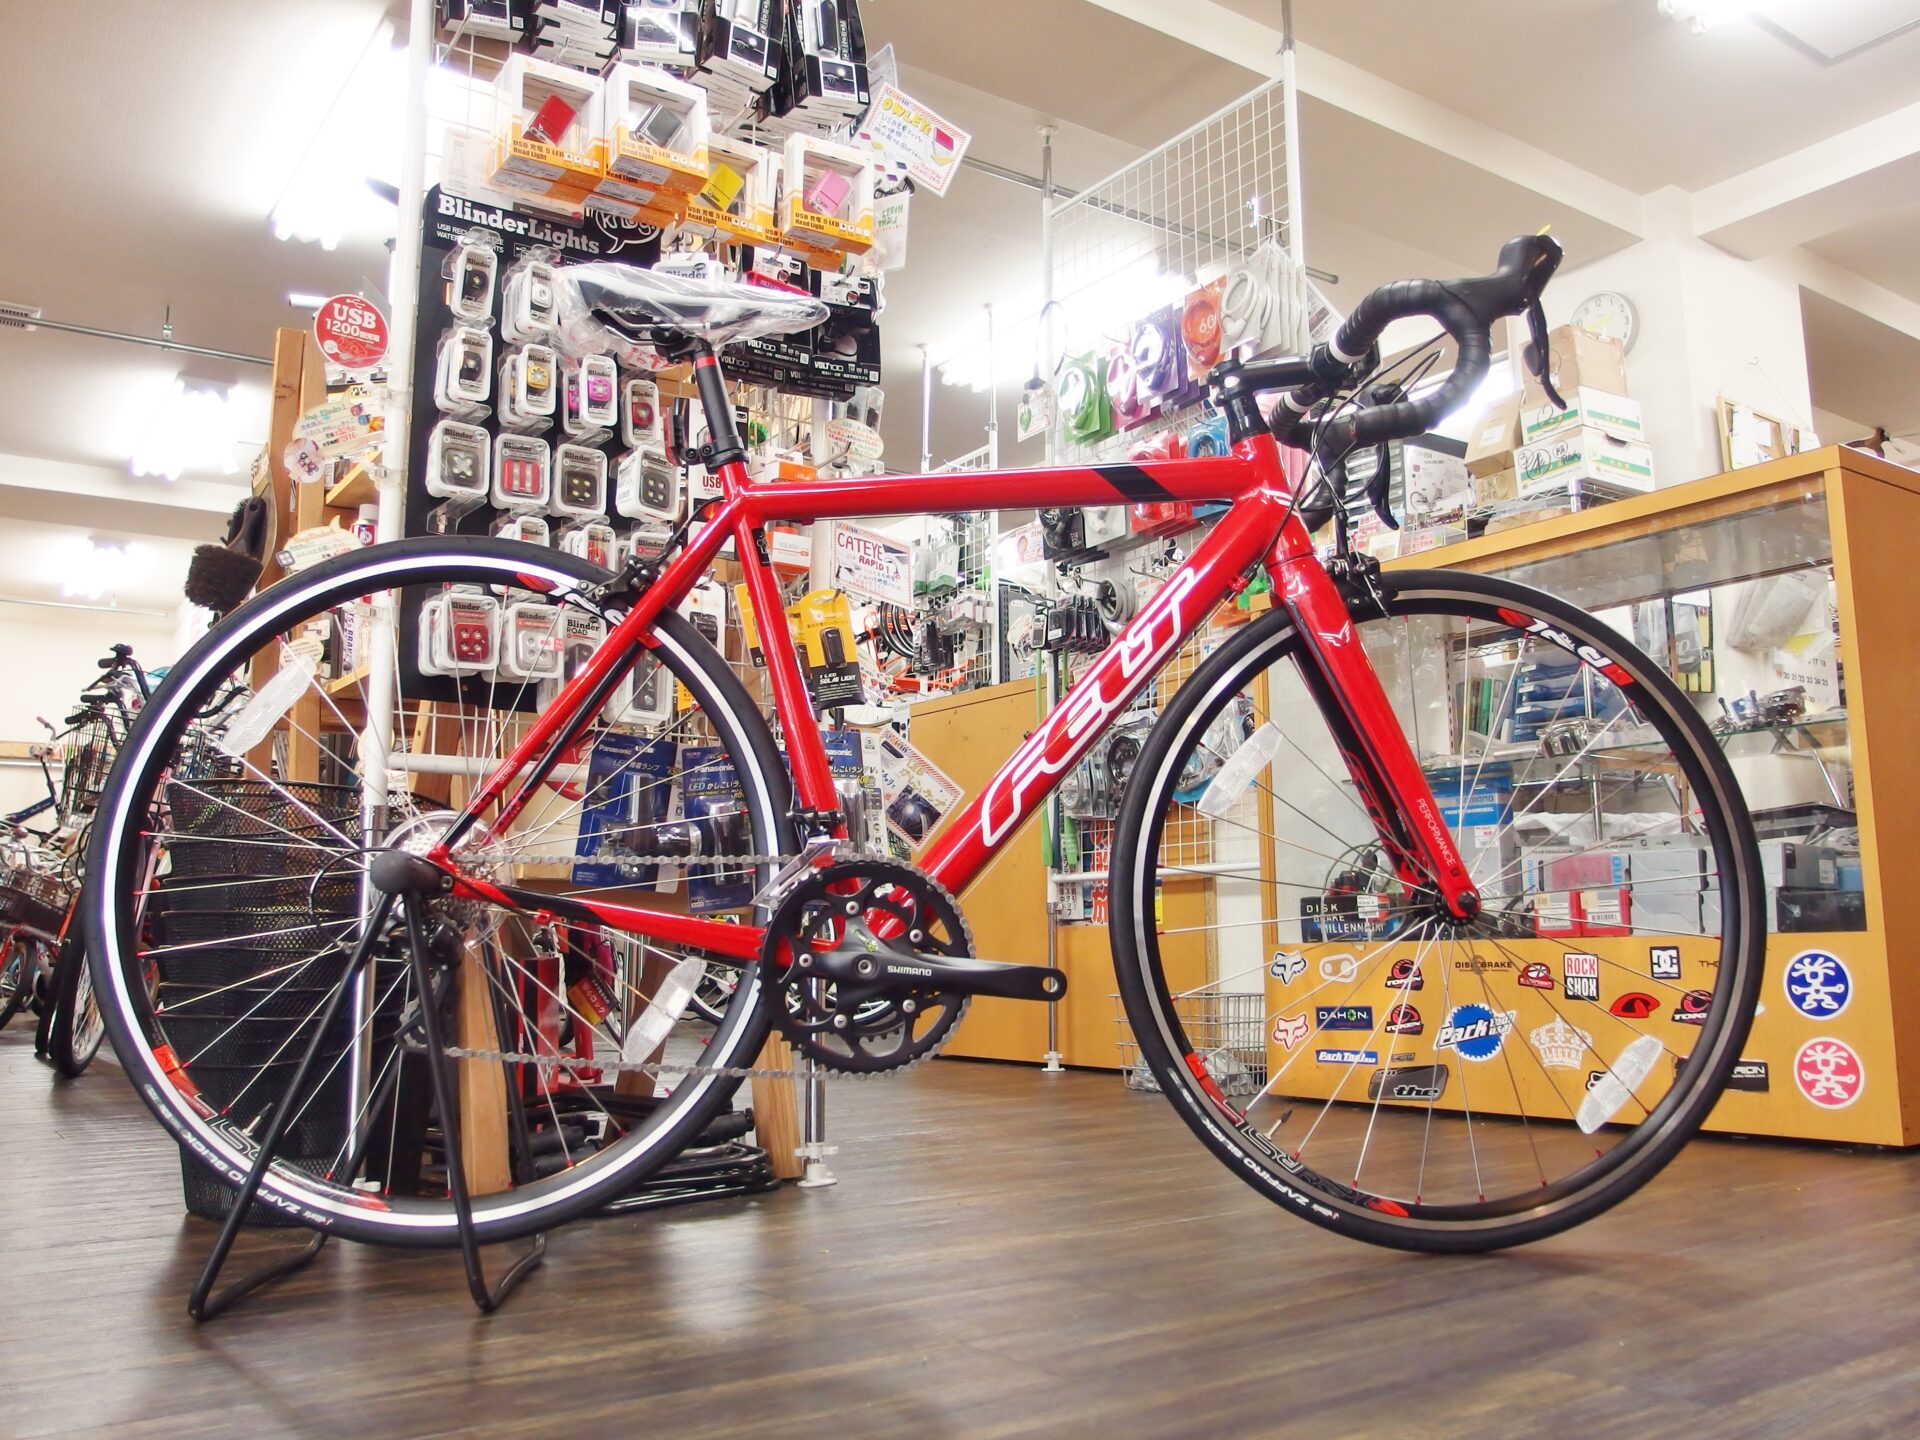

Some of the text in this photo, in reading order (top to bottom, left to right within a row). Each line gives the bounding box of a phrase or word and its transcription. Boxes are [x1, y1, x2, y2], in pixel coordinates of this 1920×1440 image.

[436, 222, 451, 232] USB
[438, 193, 600, 255] BlinderLights
[665, 269, 708, 281] Blinder
[333, 302, 377, 329] USB
[587, 369, 612, 379] Blinder
[444, 428, 474, 440] Blinder
[503, 441, 533, 452] Blinder
[565, 451, 592, 462] Blinder
[643, 452, 668, 466] Blinder
[702, 475, 722, 488] USB
[521, 527, 544, 537] Blinder
[637, 539, 665, 549] Blinder
[837, 532, 883, 561] CATEYE
[858, 555, 884, 571] RAPID
[452, 601, 481, 611] Blinder
[518, 611, 547, 621] Blinder
[566, 626, 588, 636] ROAD
[567, 618, 600, 632] Blinder
[824, 748, 853, 757] nasonic
[694, 763, 735, 774] Panasonic
[688, 782, 706, 790] LED
[1416, 798, 1457, 866] PERFORMANCE
[1306, 903, 1338, 913] DISK
[1314, 915, 1345, 923] BAKE
[887, 965, 932, 977] SHIMANO
[1481, 961, 1512, 969] BRAKE
[1566, 957, 1596, 975] ROCK
[1566, 978, 1597, 997] SHOX
[1319, 1008, 1367, 1021] DAHON
[1440, 1020, 1489, 1046] Park
[1200, 1116, 1245, 1160] SLICK
[182, 1131, 229, 1172] SLICK
[1243, 1158, 1310, 1207] ZAFFIRO
